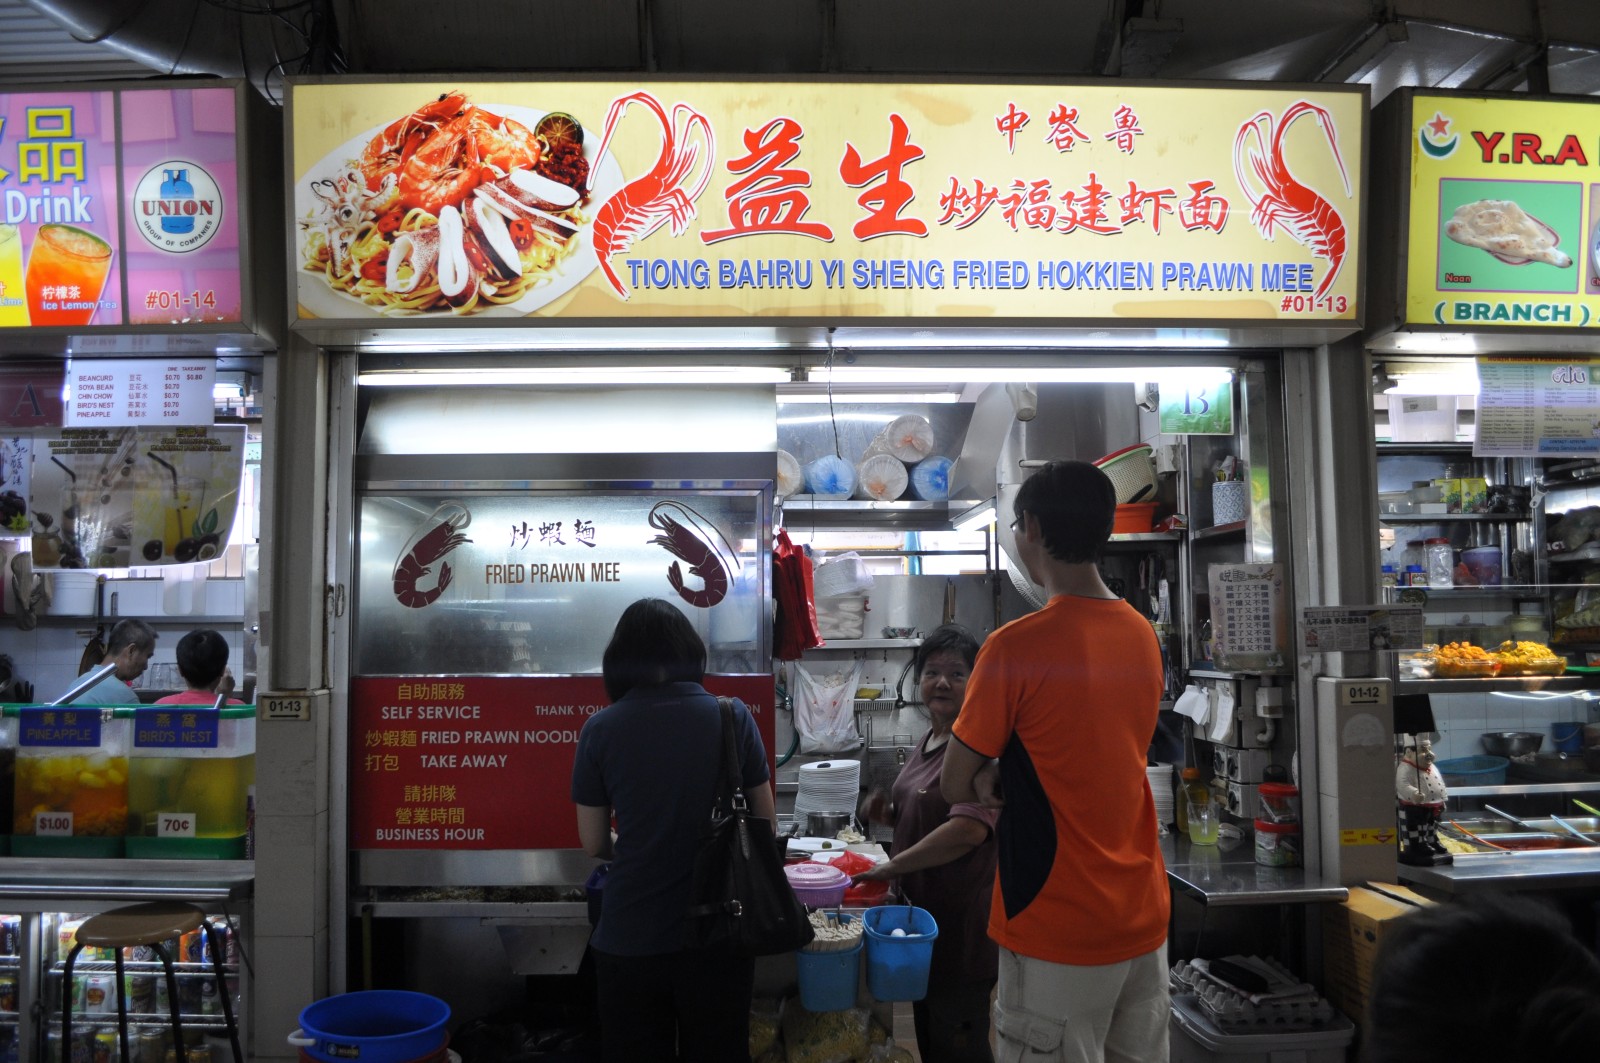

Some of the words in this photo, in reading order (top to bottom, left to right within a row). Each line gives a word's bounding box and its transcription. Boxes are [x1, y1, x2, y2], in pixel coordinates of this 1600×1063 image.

[995, 102, 1143, 152] 中峇鲁
[1472, 132, 1588, 166] Y.R.A
[700, 113, 928, 243] 益生
[5, 187, 92, 224] Drink
[142, 200, 214, 216] UNION
[937, 172, 1229, 235] 炒福建虾面
[143, 220, 162, 241] GROUP
[165, 239, 175, 247] OF
[179, 220, 213, 247] COMPANIES
[627, 259, 709, 289] TIONG
[718, 259, 812, 289] BAHRU
[821, 260, 844, 289] YI
[853, 260, 944, 289] SHENG
[953, 260, 1029, 290] FRIED
[1038, 261, 1153, 291] HOKKIEN
[1162, 262, 1252, 292] PRAWN
[1262, 263, 1313, 292] MEE
[1445, 273, 1471, 284] Naan
[42, 285, 81, 300] 柠檬茶
[146, 291, 215, 309] #01-14
[42, 301, 57, 310] Ice
[61, 301, 95, 310] Lemon
[99, 301, 117, 309] Tea
[1281, 295, 1347, 313] #01-13
[11, 384, 44, 416] A
[485, 563, 525, 584] FRIED
[531, 562, 585, 583] PRAWN
[591, 562, 620, 582] MEE
[398, 683, 465, 700] 自助服務
[1349, 687, 1379, 698] 01-12
[269, 700, 302, 712] 01-13
[382, 706, 413, 719] SELF
[418, 706, 480, 719] SERVICE
[535, 705, 574, 716] THANK
[27, 729, 91, 741] PINEAPPLE
[139, 730, 175, 742] BIRD'S
[181, 730, 213, 742] NEST
[365, 730, 417, 747] 炒蝦麵
[421, 731, 461, 744] FRIED
[465, 731, 519, 744] PRAWN
[365, 754, 399, 772] 打包
[420, 755, 456, 768] TAKE
[461, 755, 508, 767] AWAY
[404, 785, 456, 802] 請排隊
[39, 817, 69, 830] $1.00
[396, 807, 465, 825] 營業時間
[164, 819, 190, 832] 70¢
[376, 828, 440, 841] BUSINESS
[444, 828, 485, 841] HOUR
